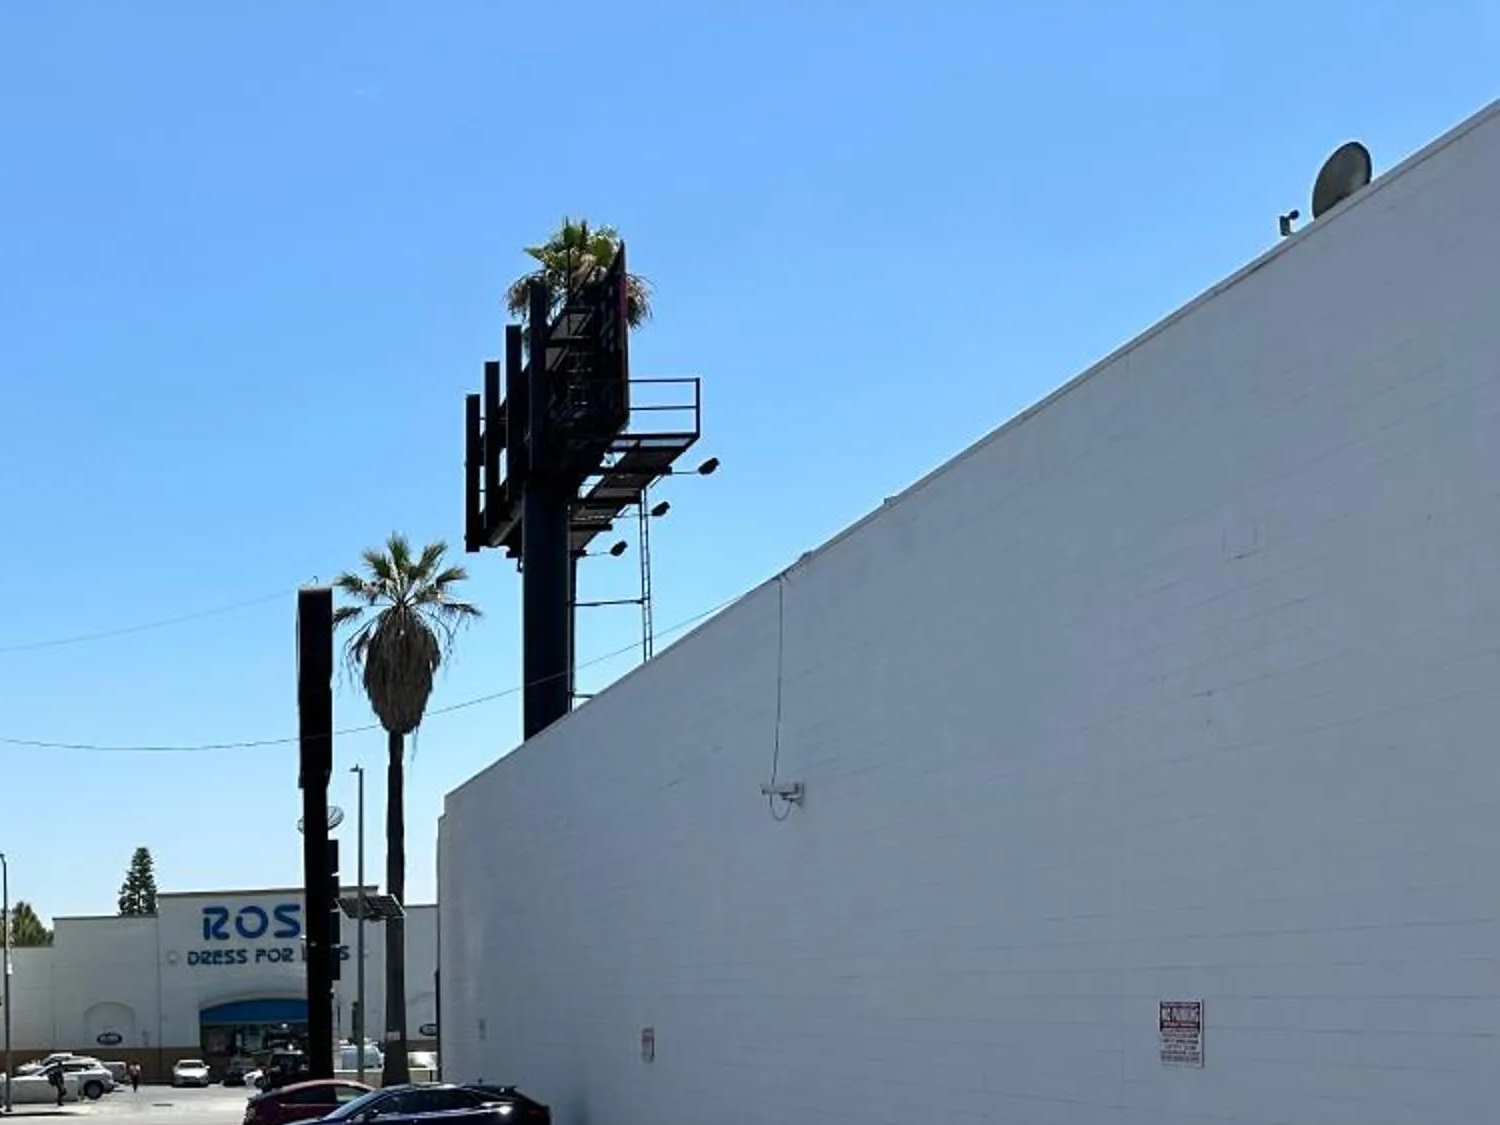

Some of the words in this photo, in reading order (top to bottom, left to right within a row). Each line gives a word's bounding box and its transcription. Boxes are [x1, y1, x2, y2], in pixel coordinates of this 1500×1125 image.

[202, 903, 302, 940] ROS
[187, 949, 248, 966] DRESS
[255, 948, 294, 963] FOR
